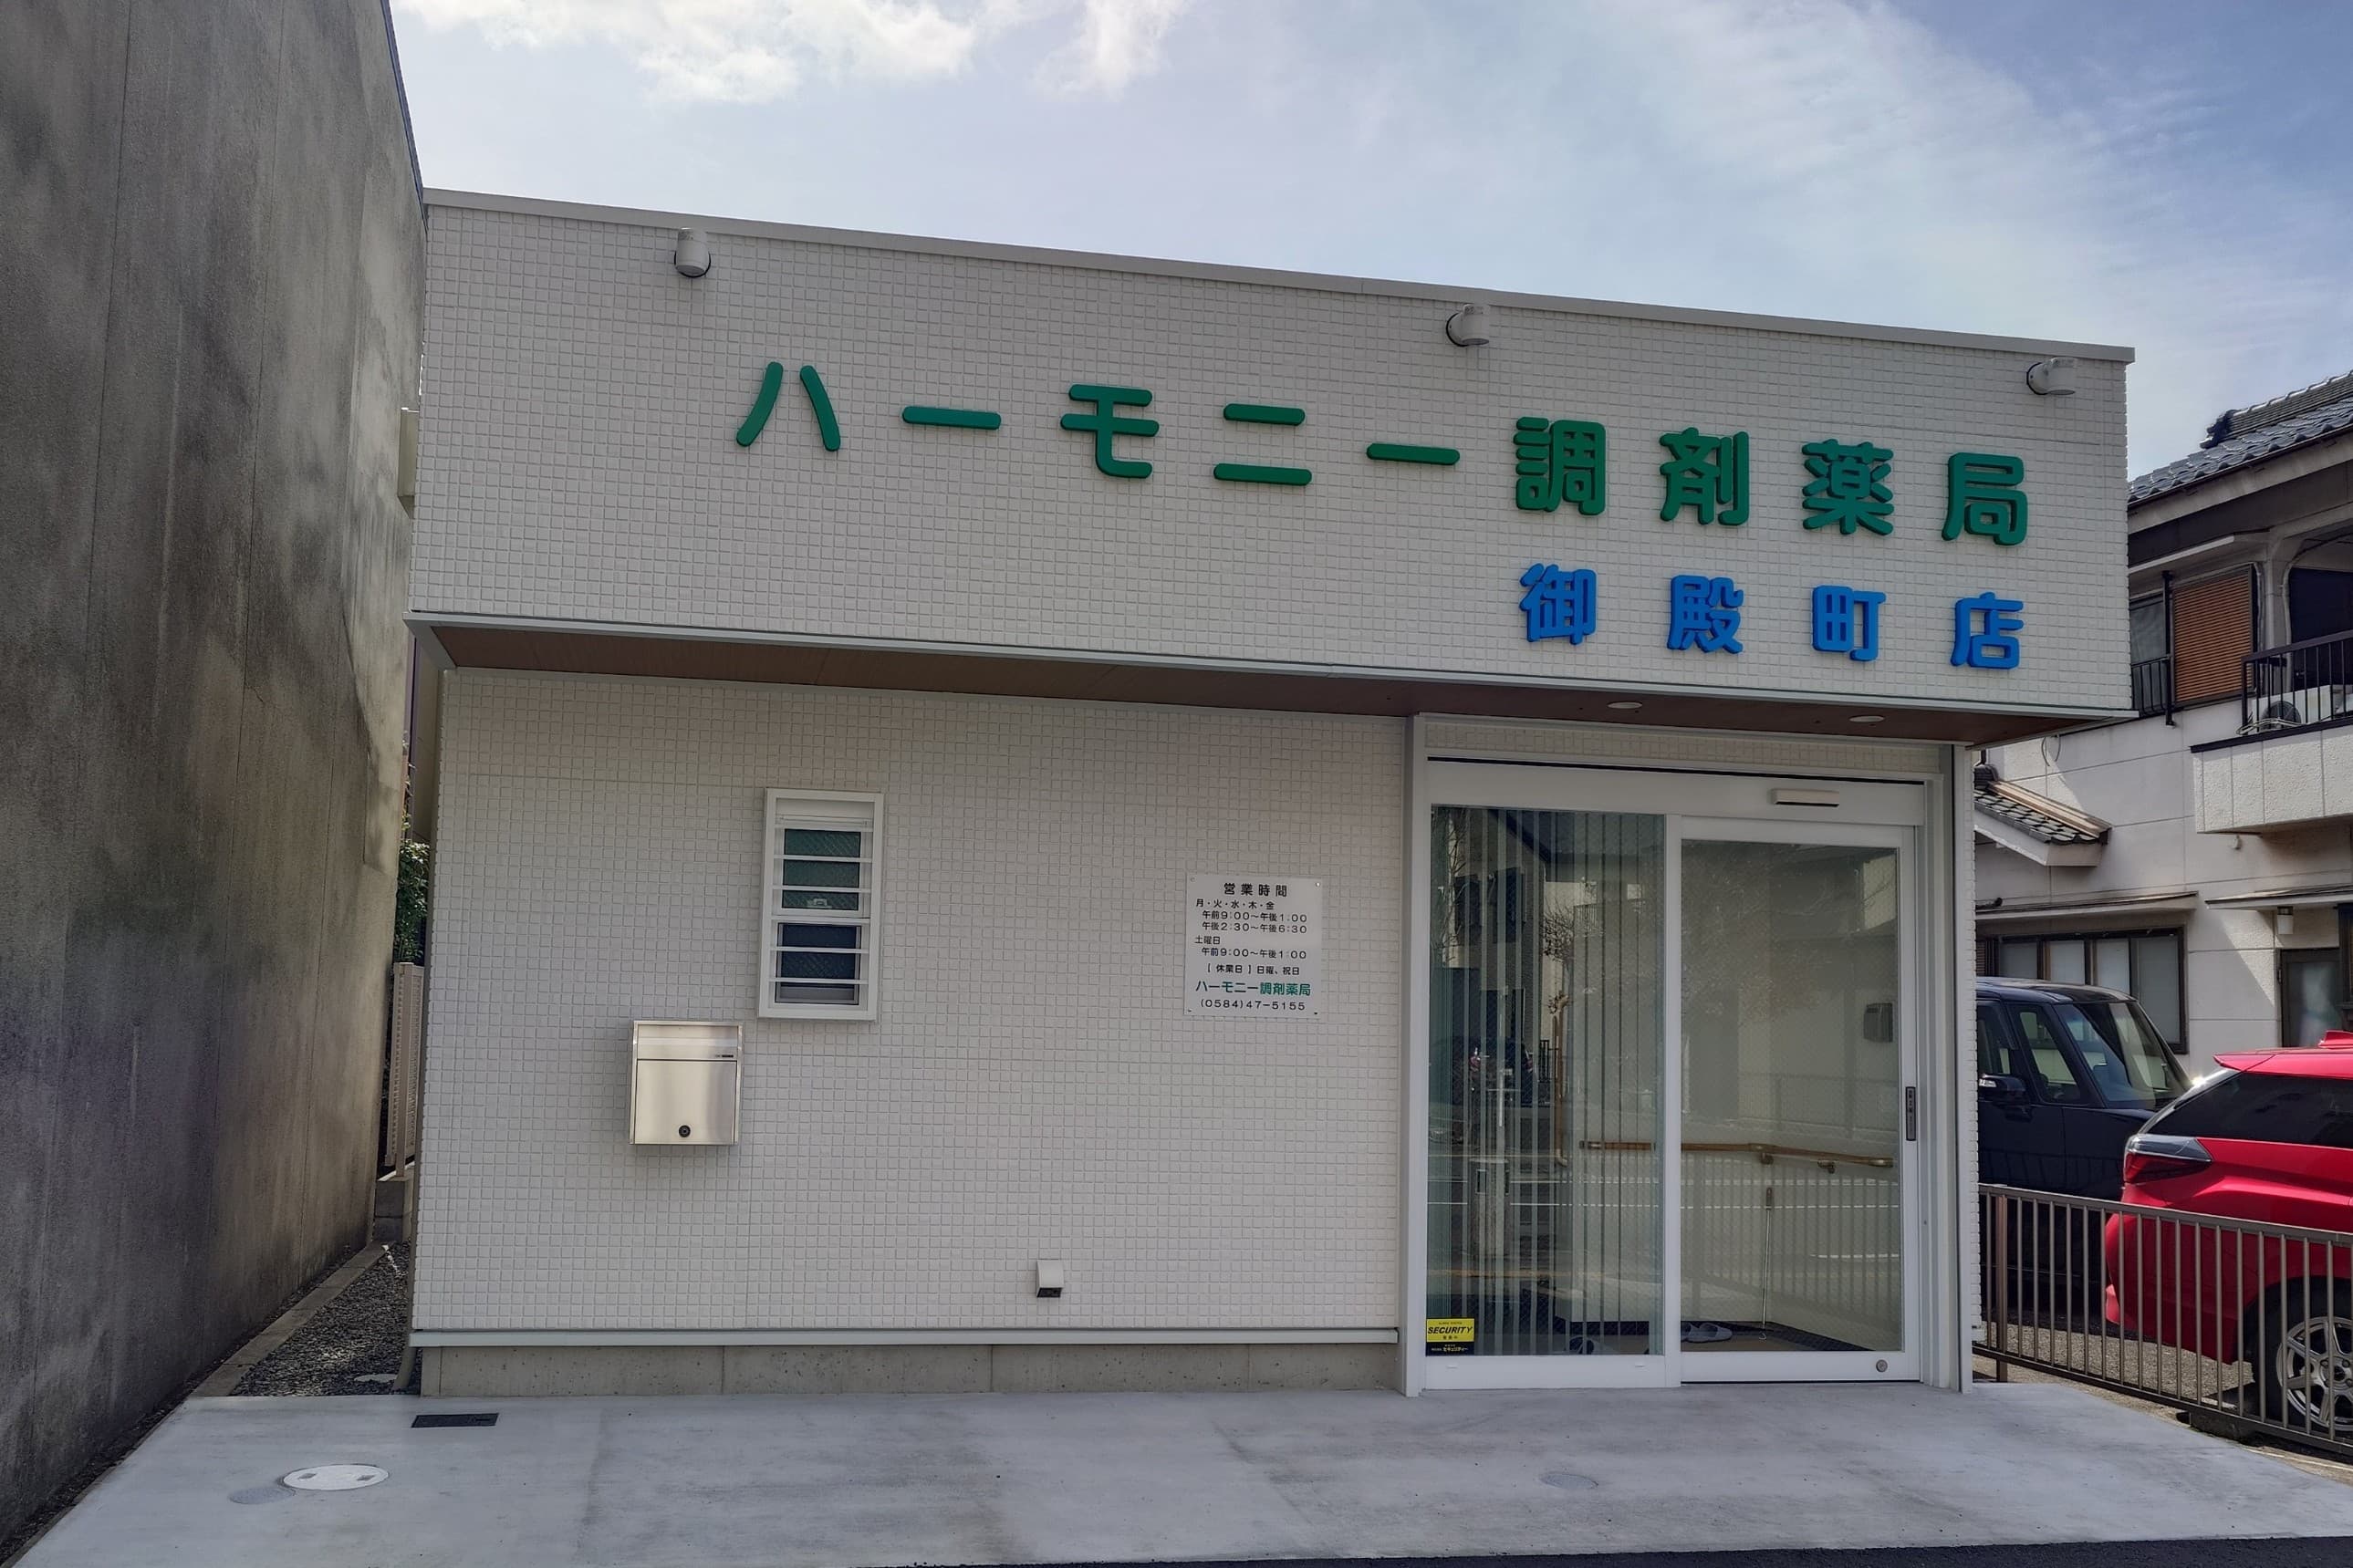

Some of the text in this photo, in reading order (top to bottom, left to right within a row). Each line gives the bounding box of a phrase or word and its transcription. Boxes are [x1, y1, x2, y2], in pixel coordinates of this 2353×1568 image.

[735, 362, 2029, 545] ハーモニー調剤薬局
[1520, 562, 2024, 670] 御殿町店
[1223, 882, 1287, 897] 営業時間
[1194, 935, 1221, 945] 土曜日
[1195, 981, 1311, 996] ハーモニー調剤薬局
